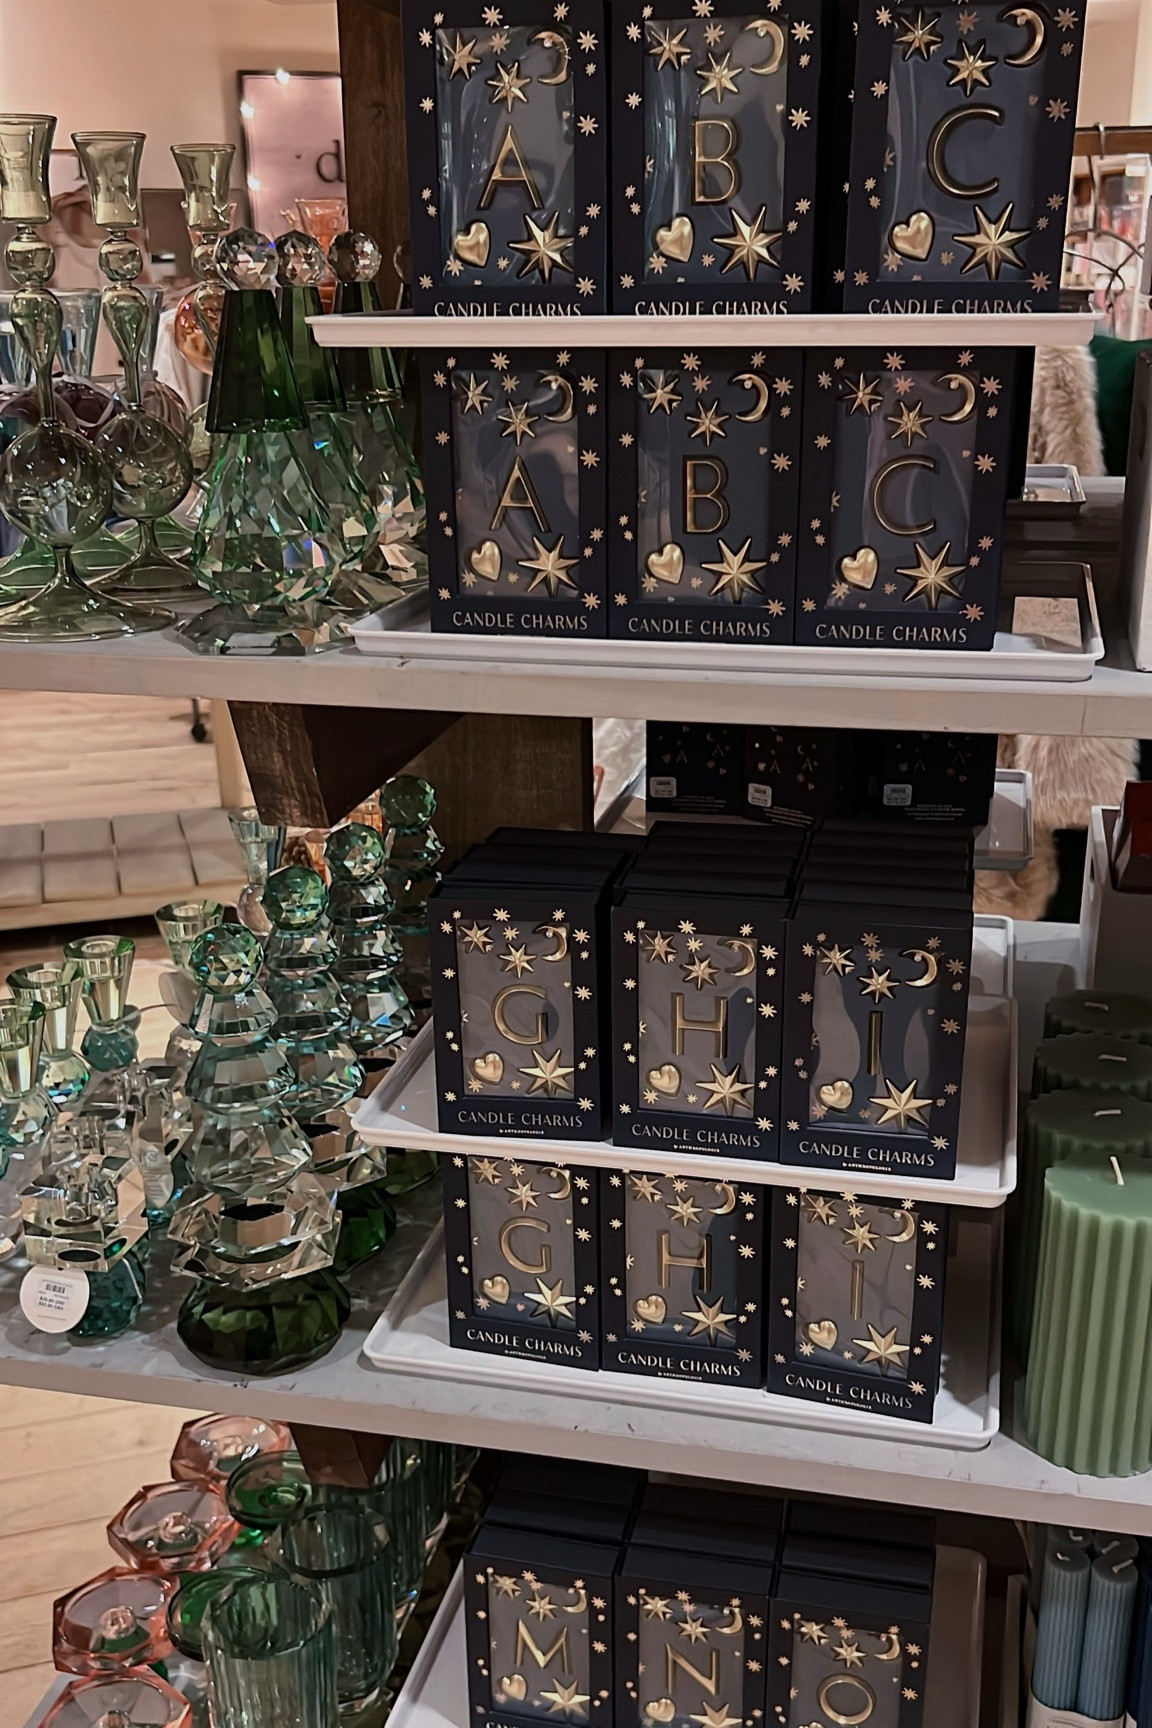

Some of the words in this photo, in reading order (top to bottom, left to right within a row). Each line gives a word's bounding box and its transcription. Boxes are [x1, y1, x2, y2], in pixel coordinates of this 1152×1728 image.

[477, 124, 544, 209] A
[693, 119, 738, 203] B
[927, 106, 1002, 198] C
[509, 303, 582, 317] CHARMS
[712, 300, 788, 315] CHARMS
[951, 299, 1032, 314] CHARMS
[489, 456, 550, 532] A
[683, 456, 729, 533] B
[872, 456, 938, 536] C
[453, 611, 514, 628] CANDLE
[521, 613, 588, 630] CHARMS
[628, 617, 693, 635] CANDLE
[700, 620, 771, 637] CHARMS
[815, 624, 885, 640] CANDLE
[892, 626, 967, 643] CHARMS
[493, 983, 550, 1045] G
[671, 991, 728, 1059] H
[458, 1110, 515, 1125] CANDLE
[521, 1113, 583, 1128] CHARMS
[632, 1123, 691, 1141] CANDLE
[696, 1130, 760, 1148] CHARMS
[799, 1140, 861, 1159] CANDLE
[867, 1148, 935, 1167] CHARMS
[500, 1216, 551, 1274] G
[658, 1230, 711, 1292] H
[466, 1328, 520, 1347] CANDLE
[525, 1338, 582, 1357] CHARMS
[618, 1352, 674, 1369] CANDLE
[680, 1359, 741, 1377] CHARMS
[785, 1373, 843, 1395] CANDLE
[849, 1386, 913, 1409] CHARMS
[516, 1619, 573, 1675] M
[667, 1643, 720, 1696] N
[817, 1673, 876, 1725] O
